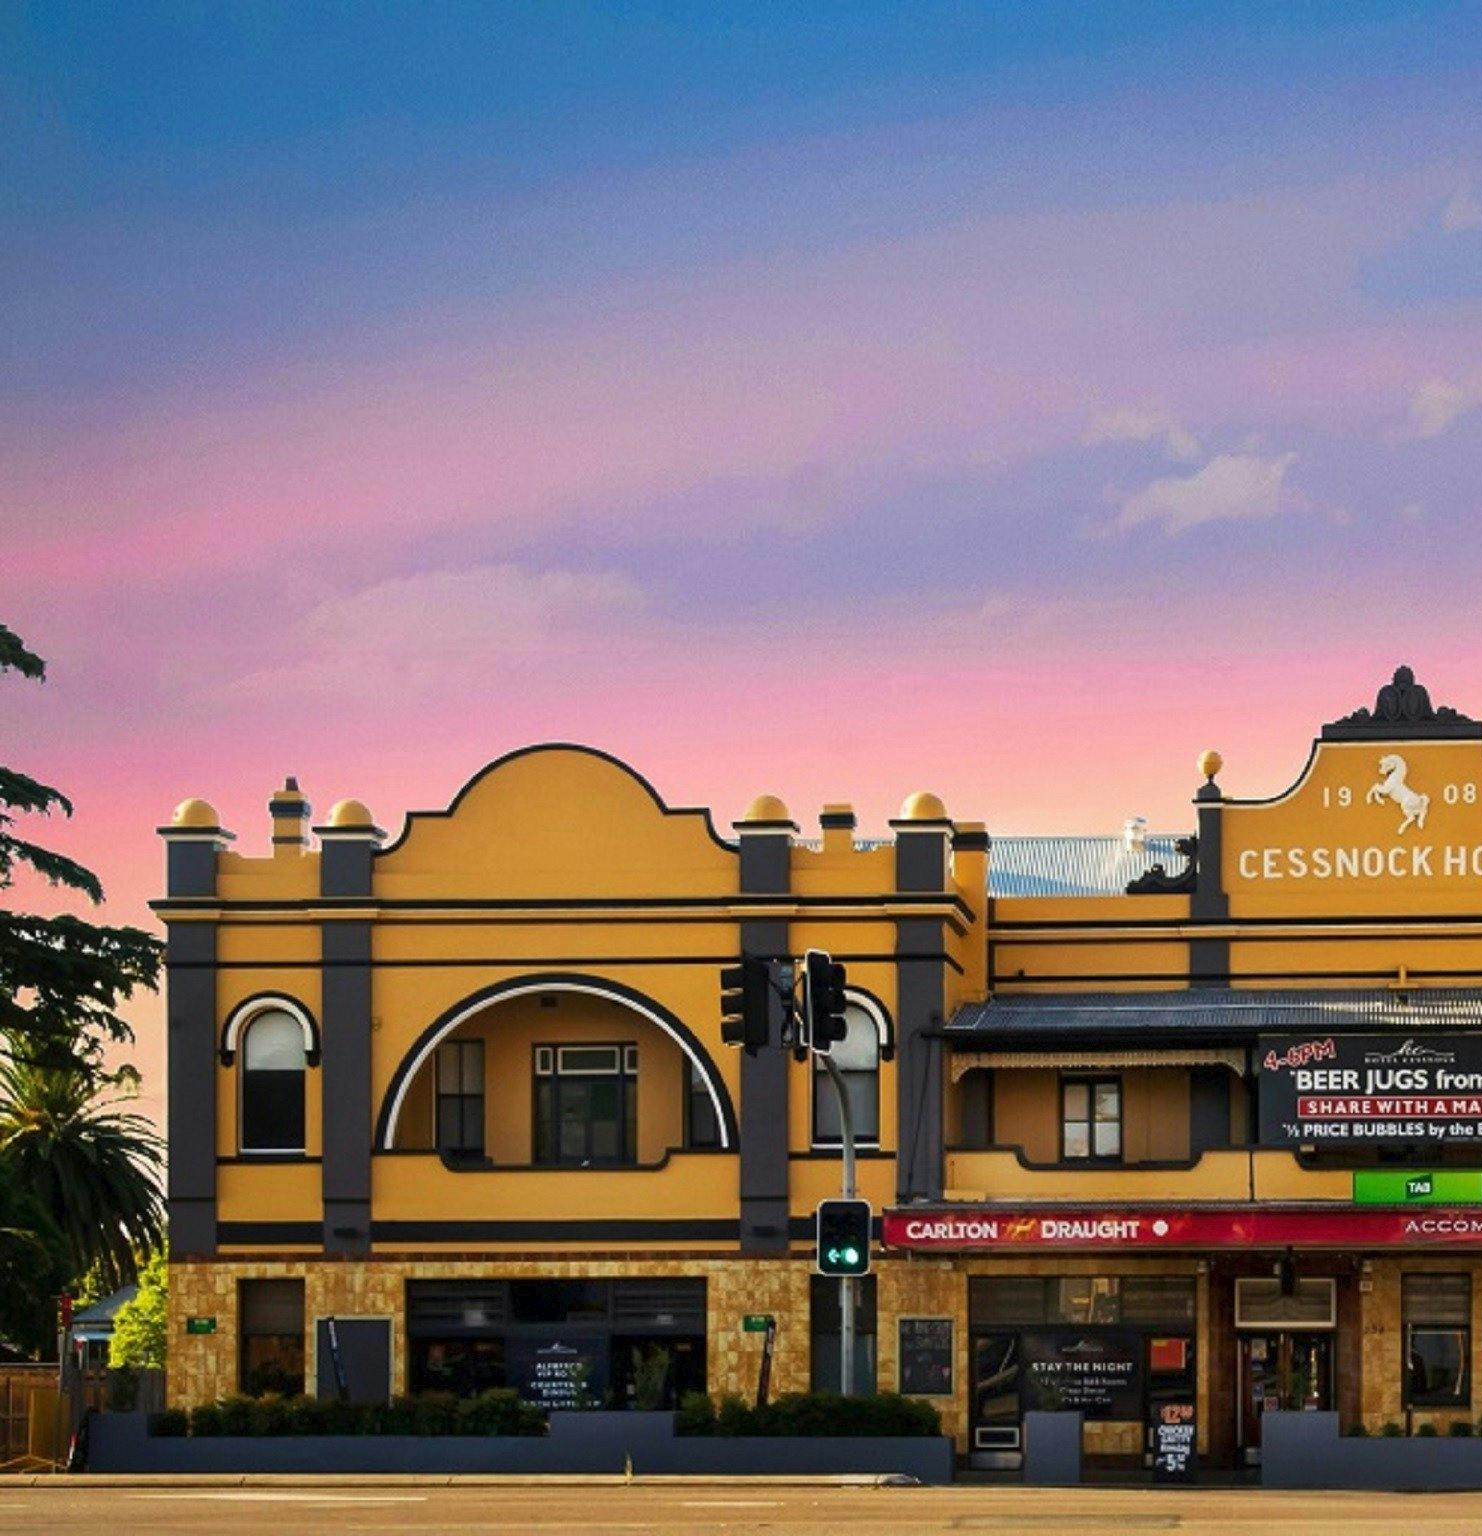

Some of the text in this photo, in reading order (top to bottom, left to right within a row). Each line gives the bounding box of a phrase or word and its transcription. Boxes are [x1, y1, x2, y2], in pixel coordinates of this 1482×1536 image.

[1323, 783, 1478, 808] 19 08
[1238, 846, 1434, 879] CESSNOCK
[1365, 1069, 1428, 1095] JUGS
[1308, 1100, 1371, 1114] SHARE
[1377, 1100, 1429, 1114] WITH
[1434, 1100, 1448, 1114] A
[1303, 1122, 1349, 1137] PRICE
[1353, 1122, 1424, 1137] BUBBLES
[1429, 1122, 1446, 1140] by
[1450, 1122, 1475, 1137] the
[1408, 1182, 1431, 1194] TAB
[906, 1219, 1140, 1240] CARLTON DRAUGHT
[1031, 1362, 1134, 1372] STAY THE NIGHT
